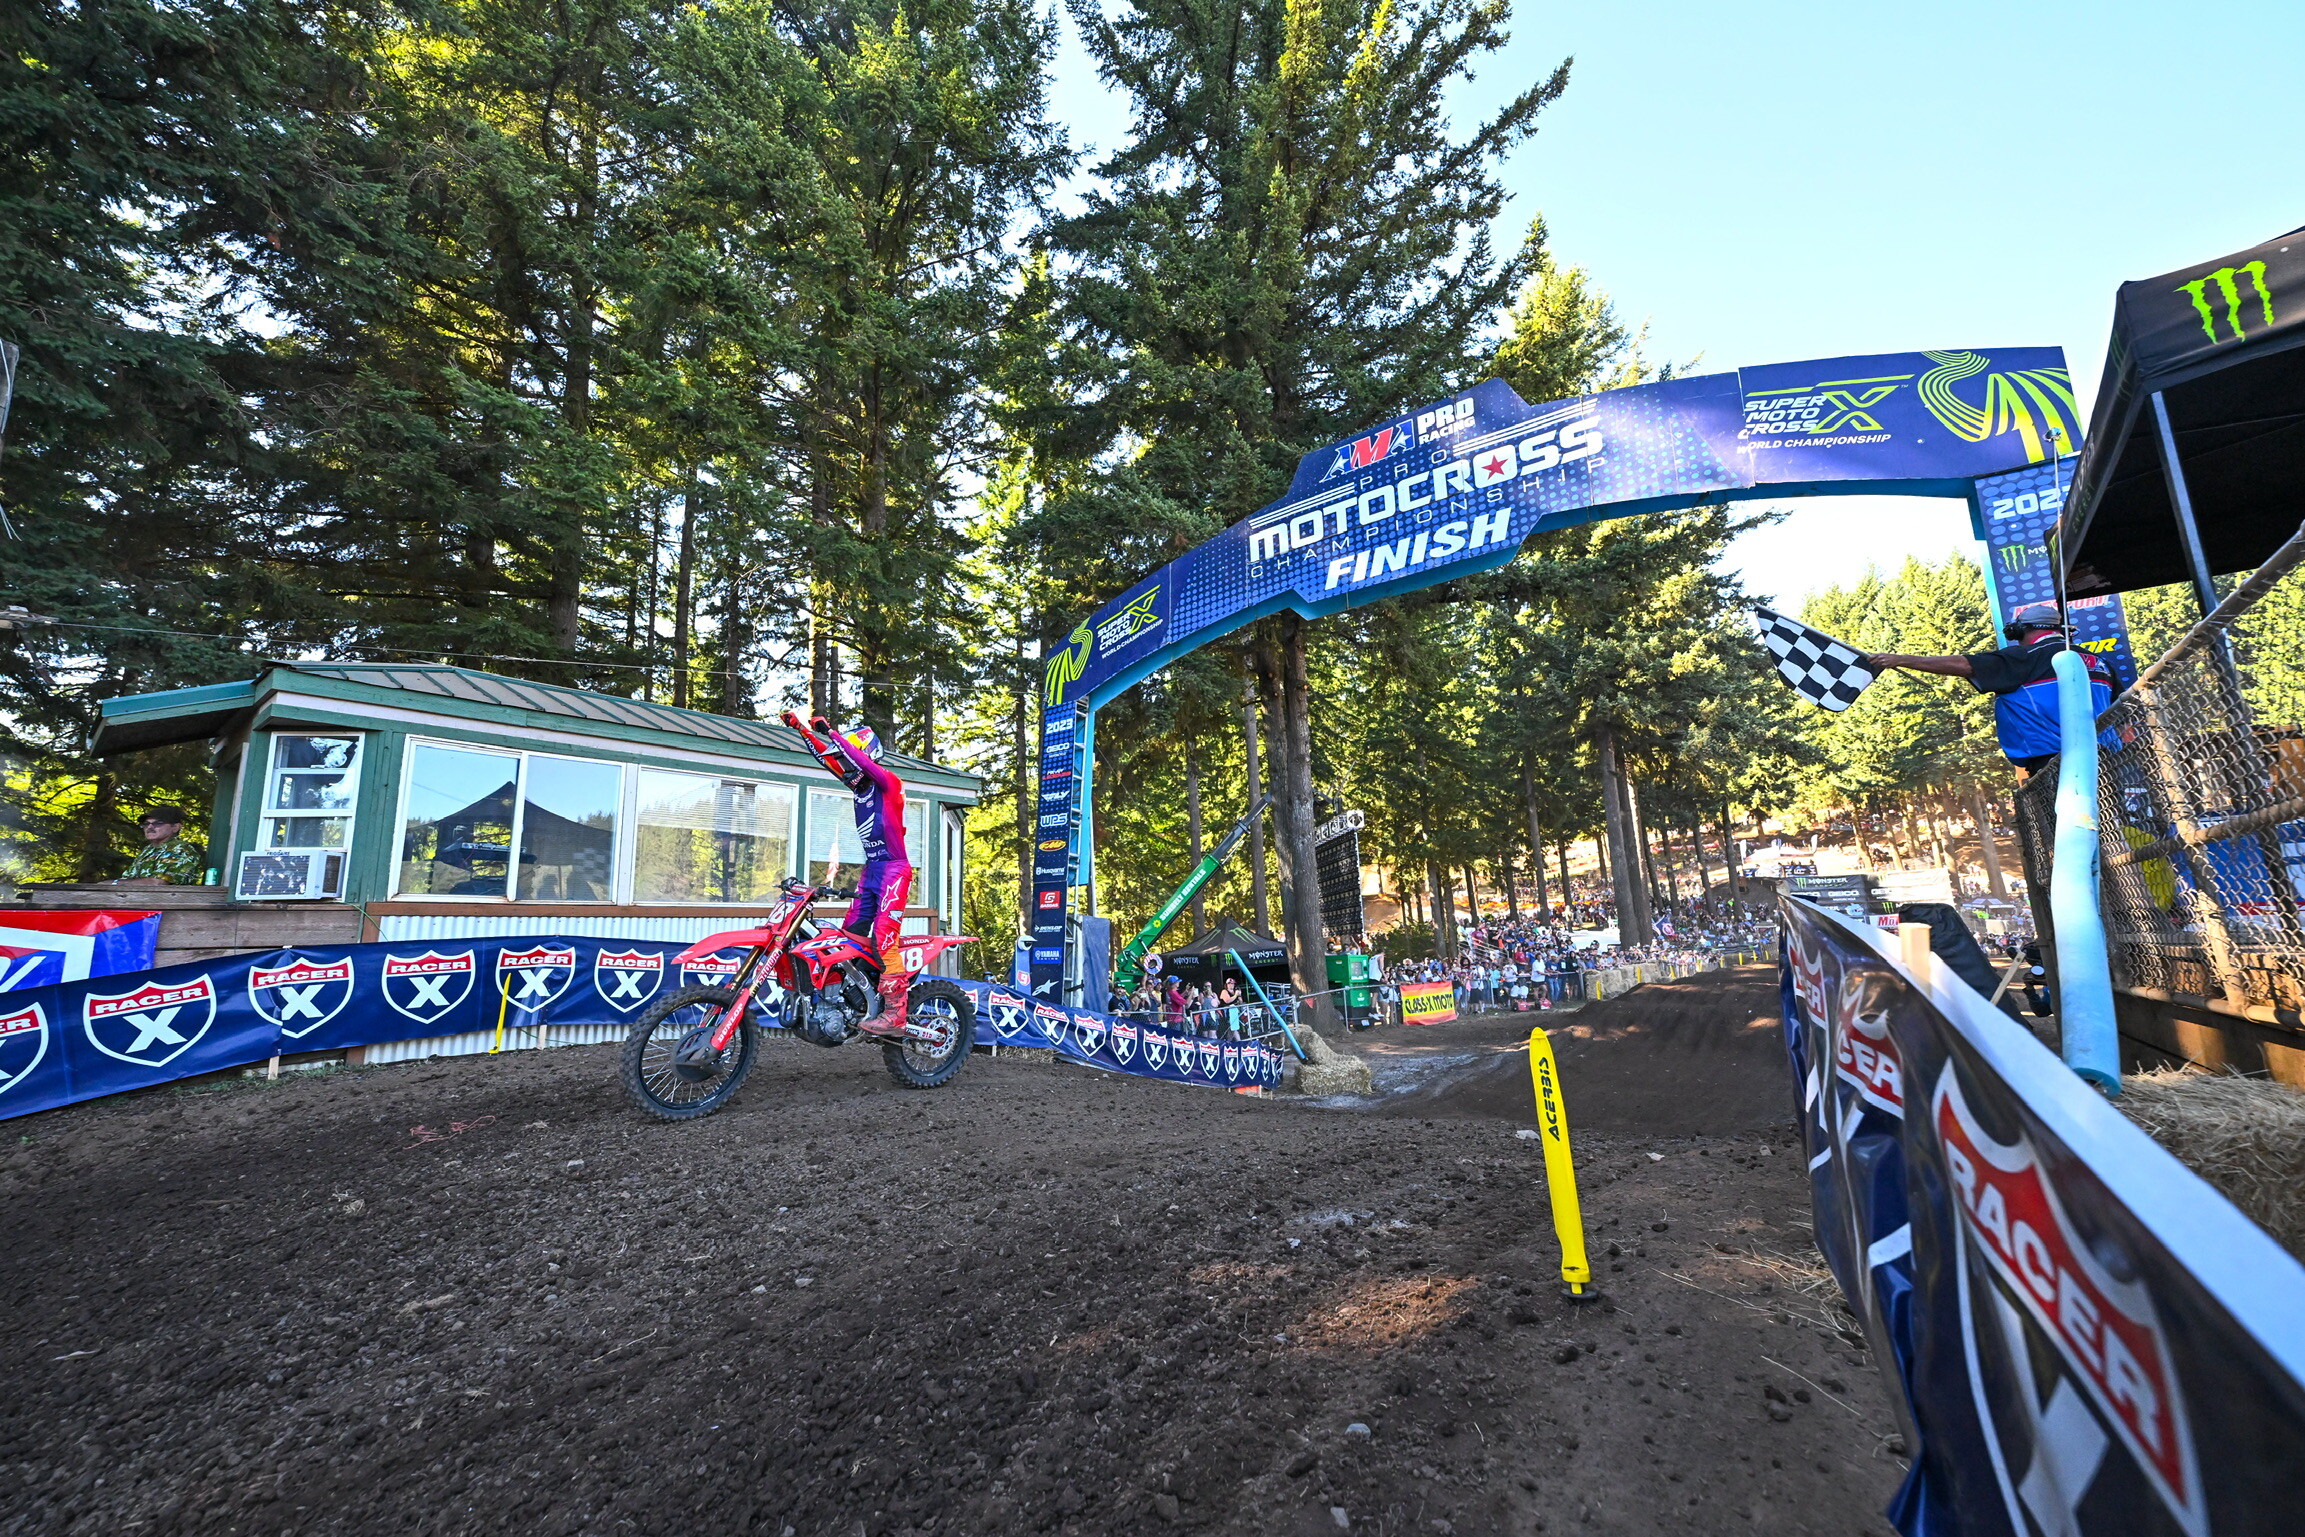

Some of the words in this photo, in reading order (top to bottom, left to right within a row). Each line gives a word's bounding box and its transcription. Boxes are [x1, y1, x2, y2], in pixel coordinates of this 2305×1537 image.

[1744, 395, 1828, 411] SUPER
[1417, 397, 1476, 435] PRO
[1745, 407, 1821, 423] MOTO
[1418, 415, 1476, 445] RACING
[1737, 419, 1819, 440] CROSS
[1319, 418, 1417, 483] AMA
[1737, 439, 1783, 455] WORLD
[1784, 434, 1892, 449] CHAMPIONSHIP
[1359, 448, 1448, 490] PRO
[1249, 415, 1604, 563] MOTOCROSS
[1993, 484, 2070, 520] 202
[1250, 456, 1606, 579] CHAMPIONSHIP
[1324, 507, 1512, 591] FINISH
[1097, 612, 1131, 638] SUPER
[1100, 619, 1131, 644] MOTO
[1099, 626, 1132, 651] CROSS
[1101, 644, 1121, 660] WORLD
[1120, 618, 1163, 648] CHAMPIONSHIP
[1046, 718, 1073, 735] 2023
[805, 737, 826, 764] HONDA
[1046, 742, 1070, 753] GEICO
[1040, 813, 1068, 828] WPS
[1181, 869, 1206, 897] RENTALS
[1808, 877, 1849, 885] MONSTER
[1827, 889, 1860, 897] GEICO
[801, 936, 849, 950] CRF
[503, 955, 569, 966] RACER
[601, 958, 658, 968] RACER
[1173, 956, 1200, 966] MONSTER
[1248, 949, 1284, 960] MONSTER
[256, 968, 345, 986] RACER
[391, 961, 468, 974] RACER
[687, 962, 737, 971] RACER
[758, 951, 780, 983] SHOWA
[405, 975, 451, 1009] X
[514, 968, 554, 999] X
[609, 970, 646, 999] X
[95, 986, 203, 1014] RACER
[279, 984, 325, 1021] X
[717, 1003, 743, 1042] DUNLOP
[998, 1007, 1019, 1028] X
[1037, 1009, 1068, 1021] RACER
[1075, 1019, 1105, 1031] RACER
[122, 1006, 188, 1053] X
[1042, 1017, 1059, 1039] X
[1083, 1028, 1099, 1049] X
[1118, 1038, 1130, 1057] X
[1150, 1043, 1161, 1062] X
[1179, 1049, 1191, 1067] X
[1205, 1054, 1215, 1071] X
[1539, 1056, 1561, 1142] ACERBIS
[1944, 1137, 2166, 1462] RACER
